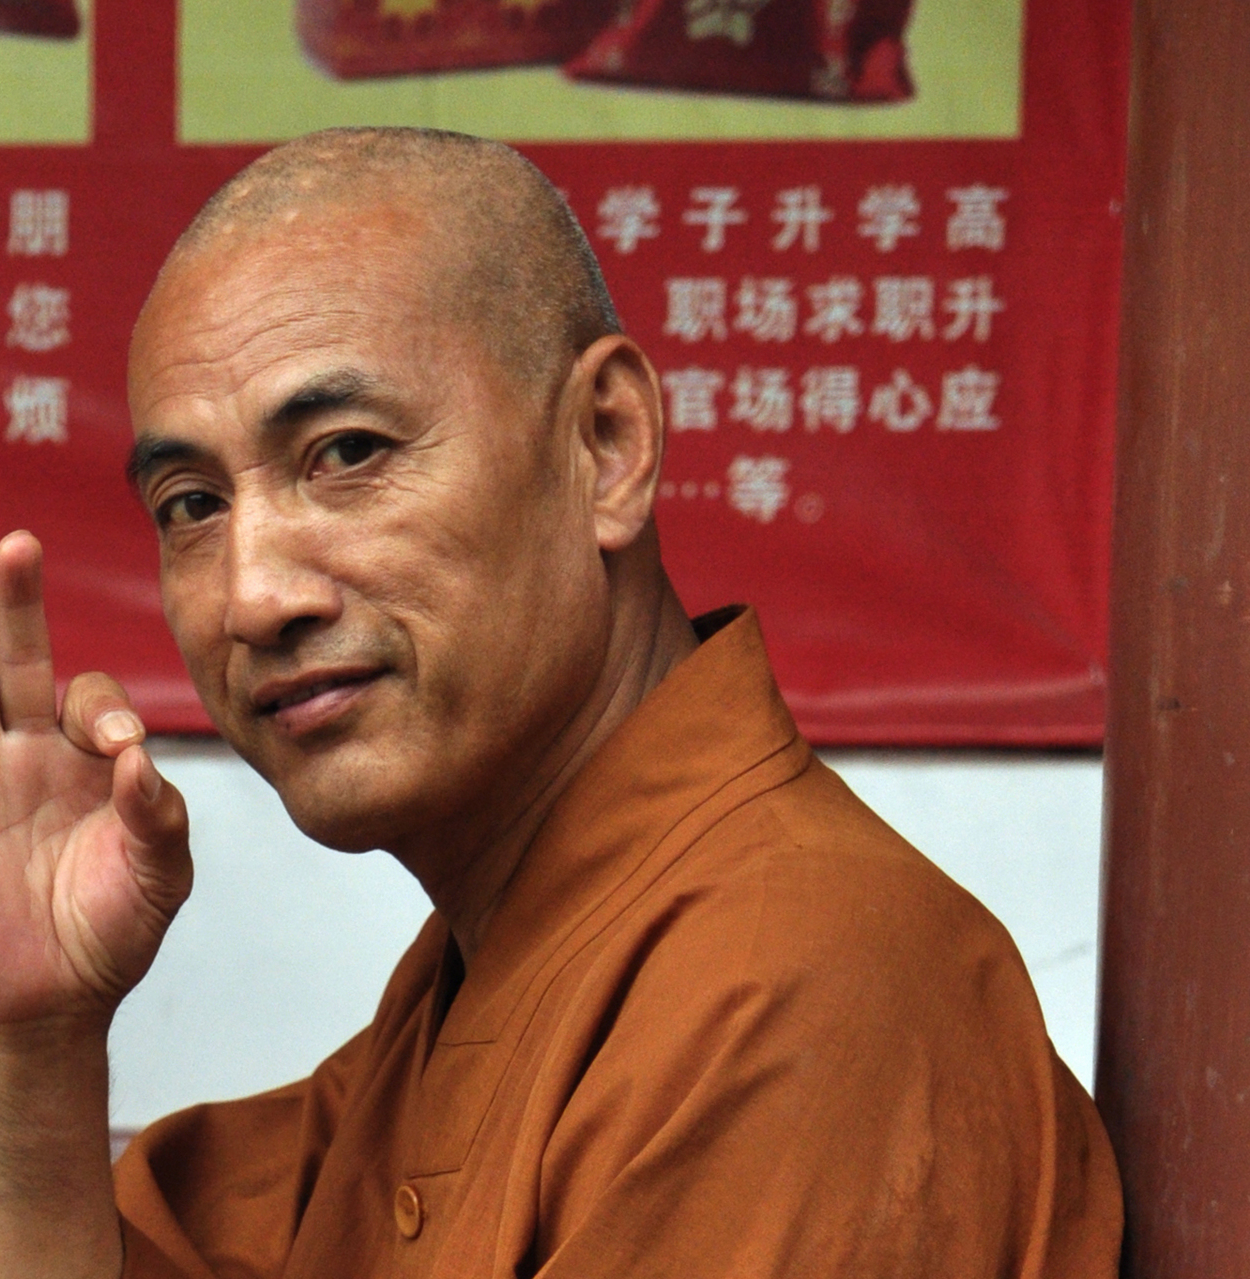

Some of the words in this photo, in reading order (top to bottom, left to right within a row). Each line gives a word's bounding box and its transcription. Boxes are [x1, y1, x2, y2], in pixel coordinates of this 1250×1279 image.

[596, 186, 1006, 254] 学子升学高
[664, 277, 1002, 343] 职场求职升
[661, 366, 999, 433] 官场得心应
